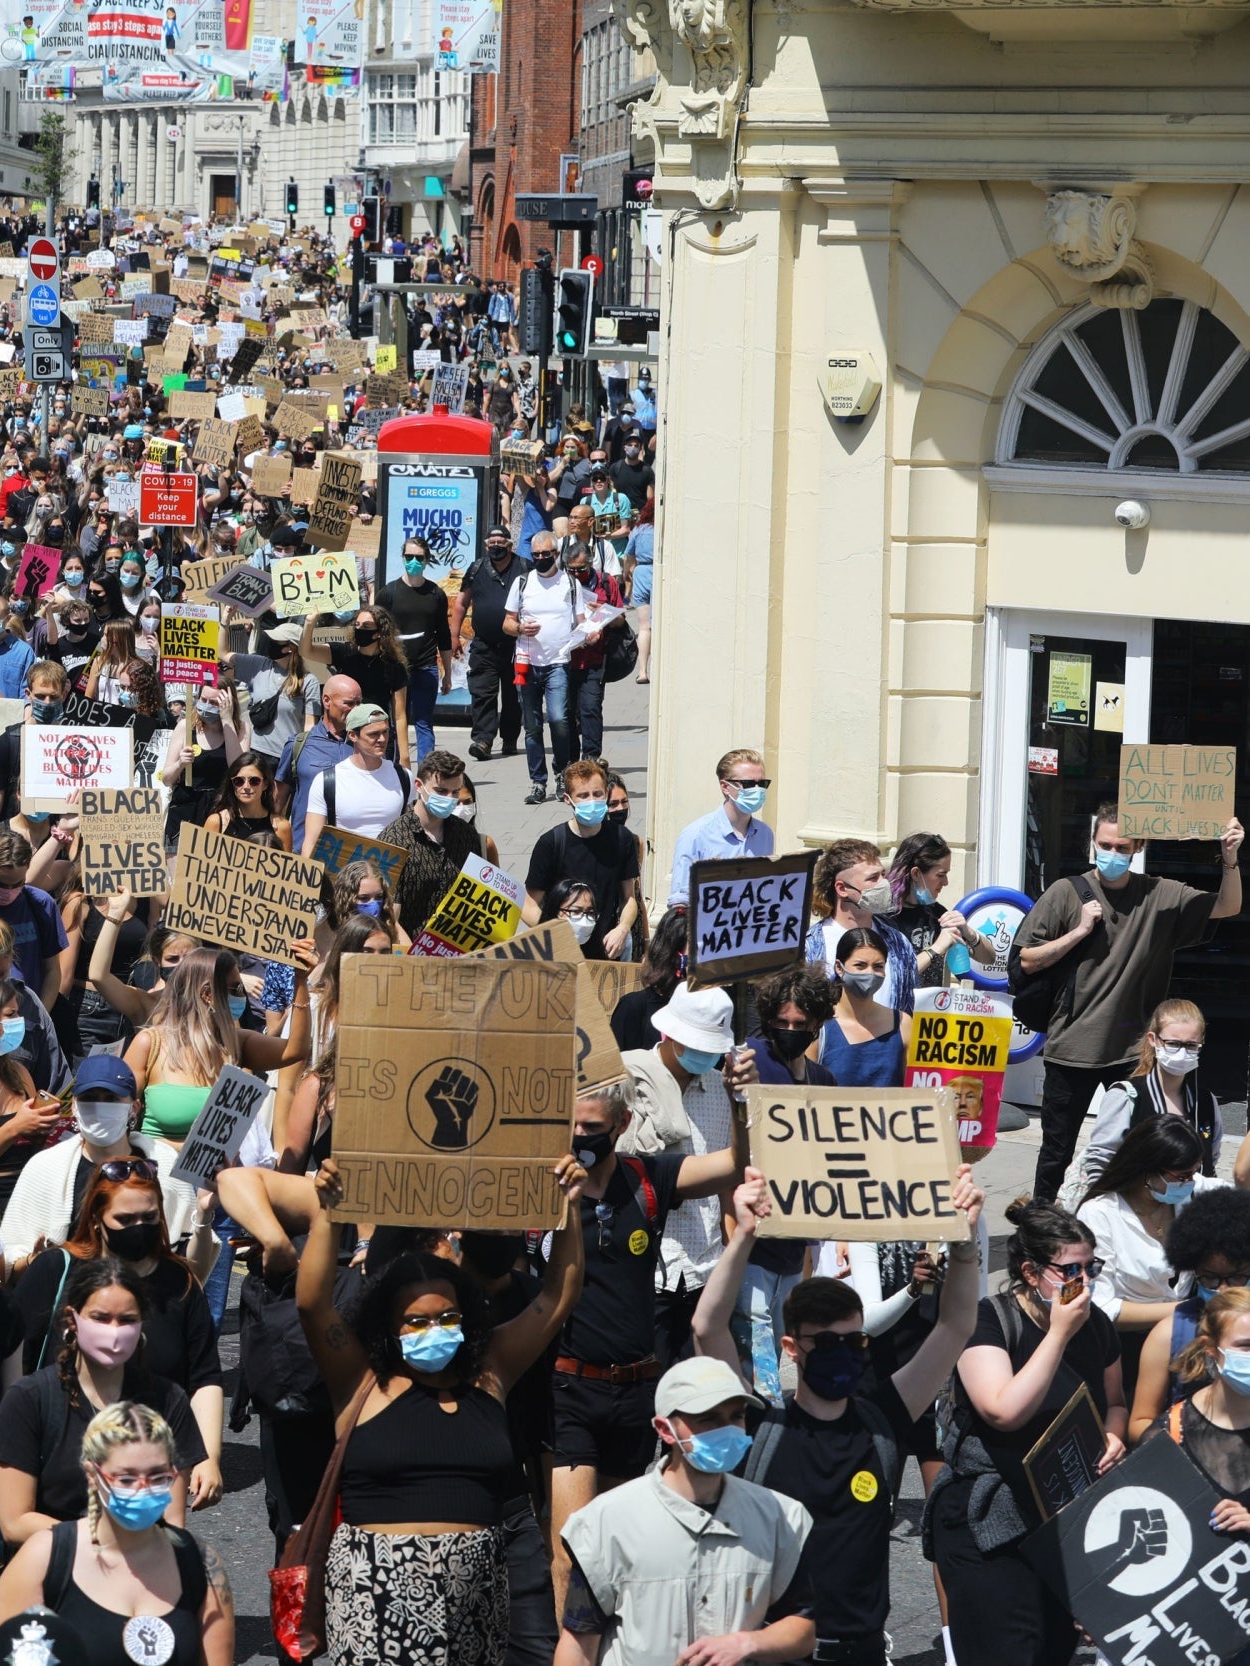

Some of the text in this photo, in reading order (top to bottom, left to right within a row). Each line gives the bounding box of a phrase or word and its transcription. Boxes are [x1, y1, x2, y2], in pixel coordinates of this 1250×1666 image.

[198, 11, 222, 20] PROTECT
[58, 22, 83, 33] SOCIAL
[195, 22, 222, 31] YOURSELF
[337, 22, 358, 32] PLEASE
[41, 35, 84, 48] DISTANCING
[343, 33, 358, 42] KEEP
[479, 34, 497, 45] SAVE
[334, 43, 358, 53] MOVING
[477, 48, 497, 59] LIVES
[353, 217, 362, 227] B
[587, 260, 597, 272] C
[38, 336, 59, 345] Only
[223, 386, 258, 396] RACISM
[203, 419, 233, 437] BLACK
[203, 437, 228, 448] LIVES
[143, 477, 176, 487] COVID
[110, 484, 135, 496] BLACK
[419, 488, 457, 498] GREGGS
[157, 492, 180, 503] Keep
[157, 503, 179, 512] your
[148, 512, 187, 522] distance
[402, 507, 463, 528] MUCHO
[235, 572, 273, 595] TRANS
[163, 618, 206, 633] BLACK
[163, 630, 200, 645] LIVES
[163, 643, 216, 661] MATTER
[163, 659, 203, 670] No justice
[163, 667, 199, 679] No peace
[38, 733, 116, 745] NOT ALL LIVES
[42, 748, 112, 760] MATTER TILL
[42, 762, 112, 775] BLACK LIVES
[1125, 748, 1237, 777] ALL LIVES
[55, 777, 99, 789] MATTER
[1123, 778, 1224, 803] DON'T MATTER
[81, 789, 162, 816] BLACK
[1154, 804, 1185, 814] UNTIL
[81, 815, 164, 824] TRANS QUEER POOR
[81, 823, 164, 833] DISABLED SEX WORKERS
[83, 831, 162, 841] IMMIGRANT HOMELESS
[84, 841, 163, 869] LIVES
[84, 868, 167, 895] MATTER
[453, 876, 513, 923] BLACK
[702, 877, 799, 914] BLACK
[186, 881, 309, 940] UNDERSTAND
[442, 896, 497, 937] LIVES
[713, 903, 780, 928] LIVES
[701, 916, 799, 954] MATTER
[358, 963, 477, 1014] THE
[499, 968, 578, 1021] UK
[954, 994, 991, 1005] STAND UP
[953, 1003, 995, 1014] TO RACISM
[919, 1016, 984, 1043] NO TO
[915, 1040, 998, 1067] RACISM
[339, 1057, 574, 1115] IS NOT
[214, 1077, 262, 1118] BLACK
[197, 1105, 238, 1145] LIVES
[767, 1104, 939, 1143] SILENCE
[179, 1139, 226, 1181] MATTER
[333, 1159, 565, 1218] INNOCENT
[768, 1179, 958, 1220] VIOLENCE
[856, 1483, 869, 1492] Lives
